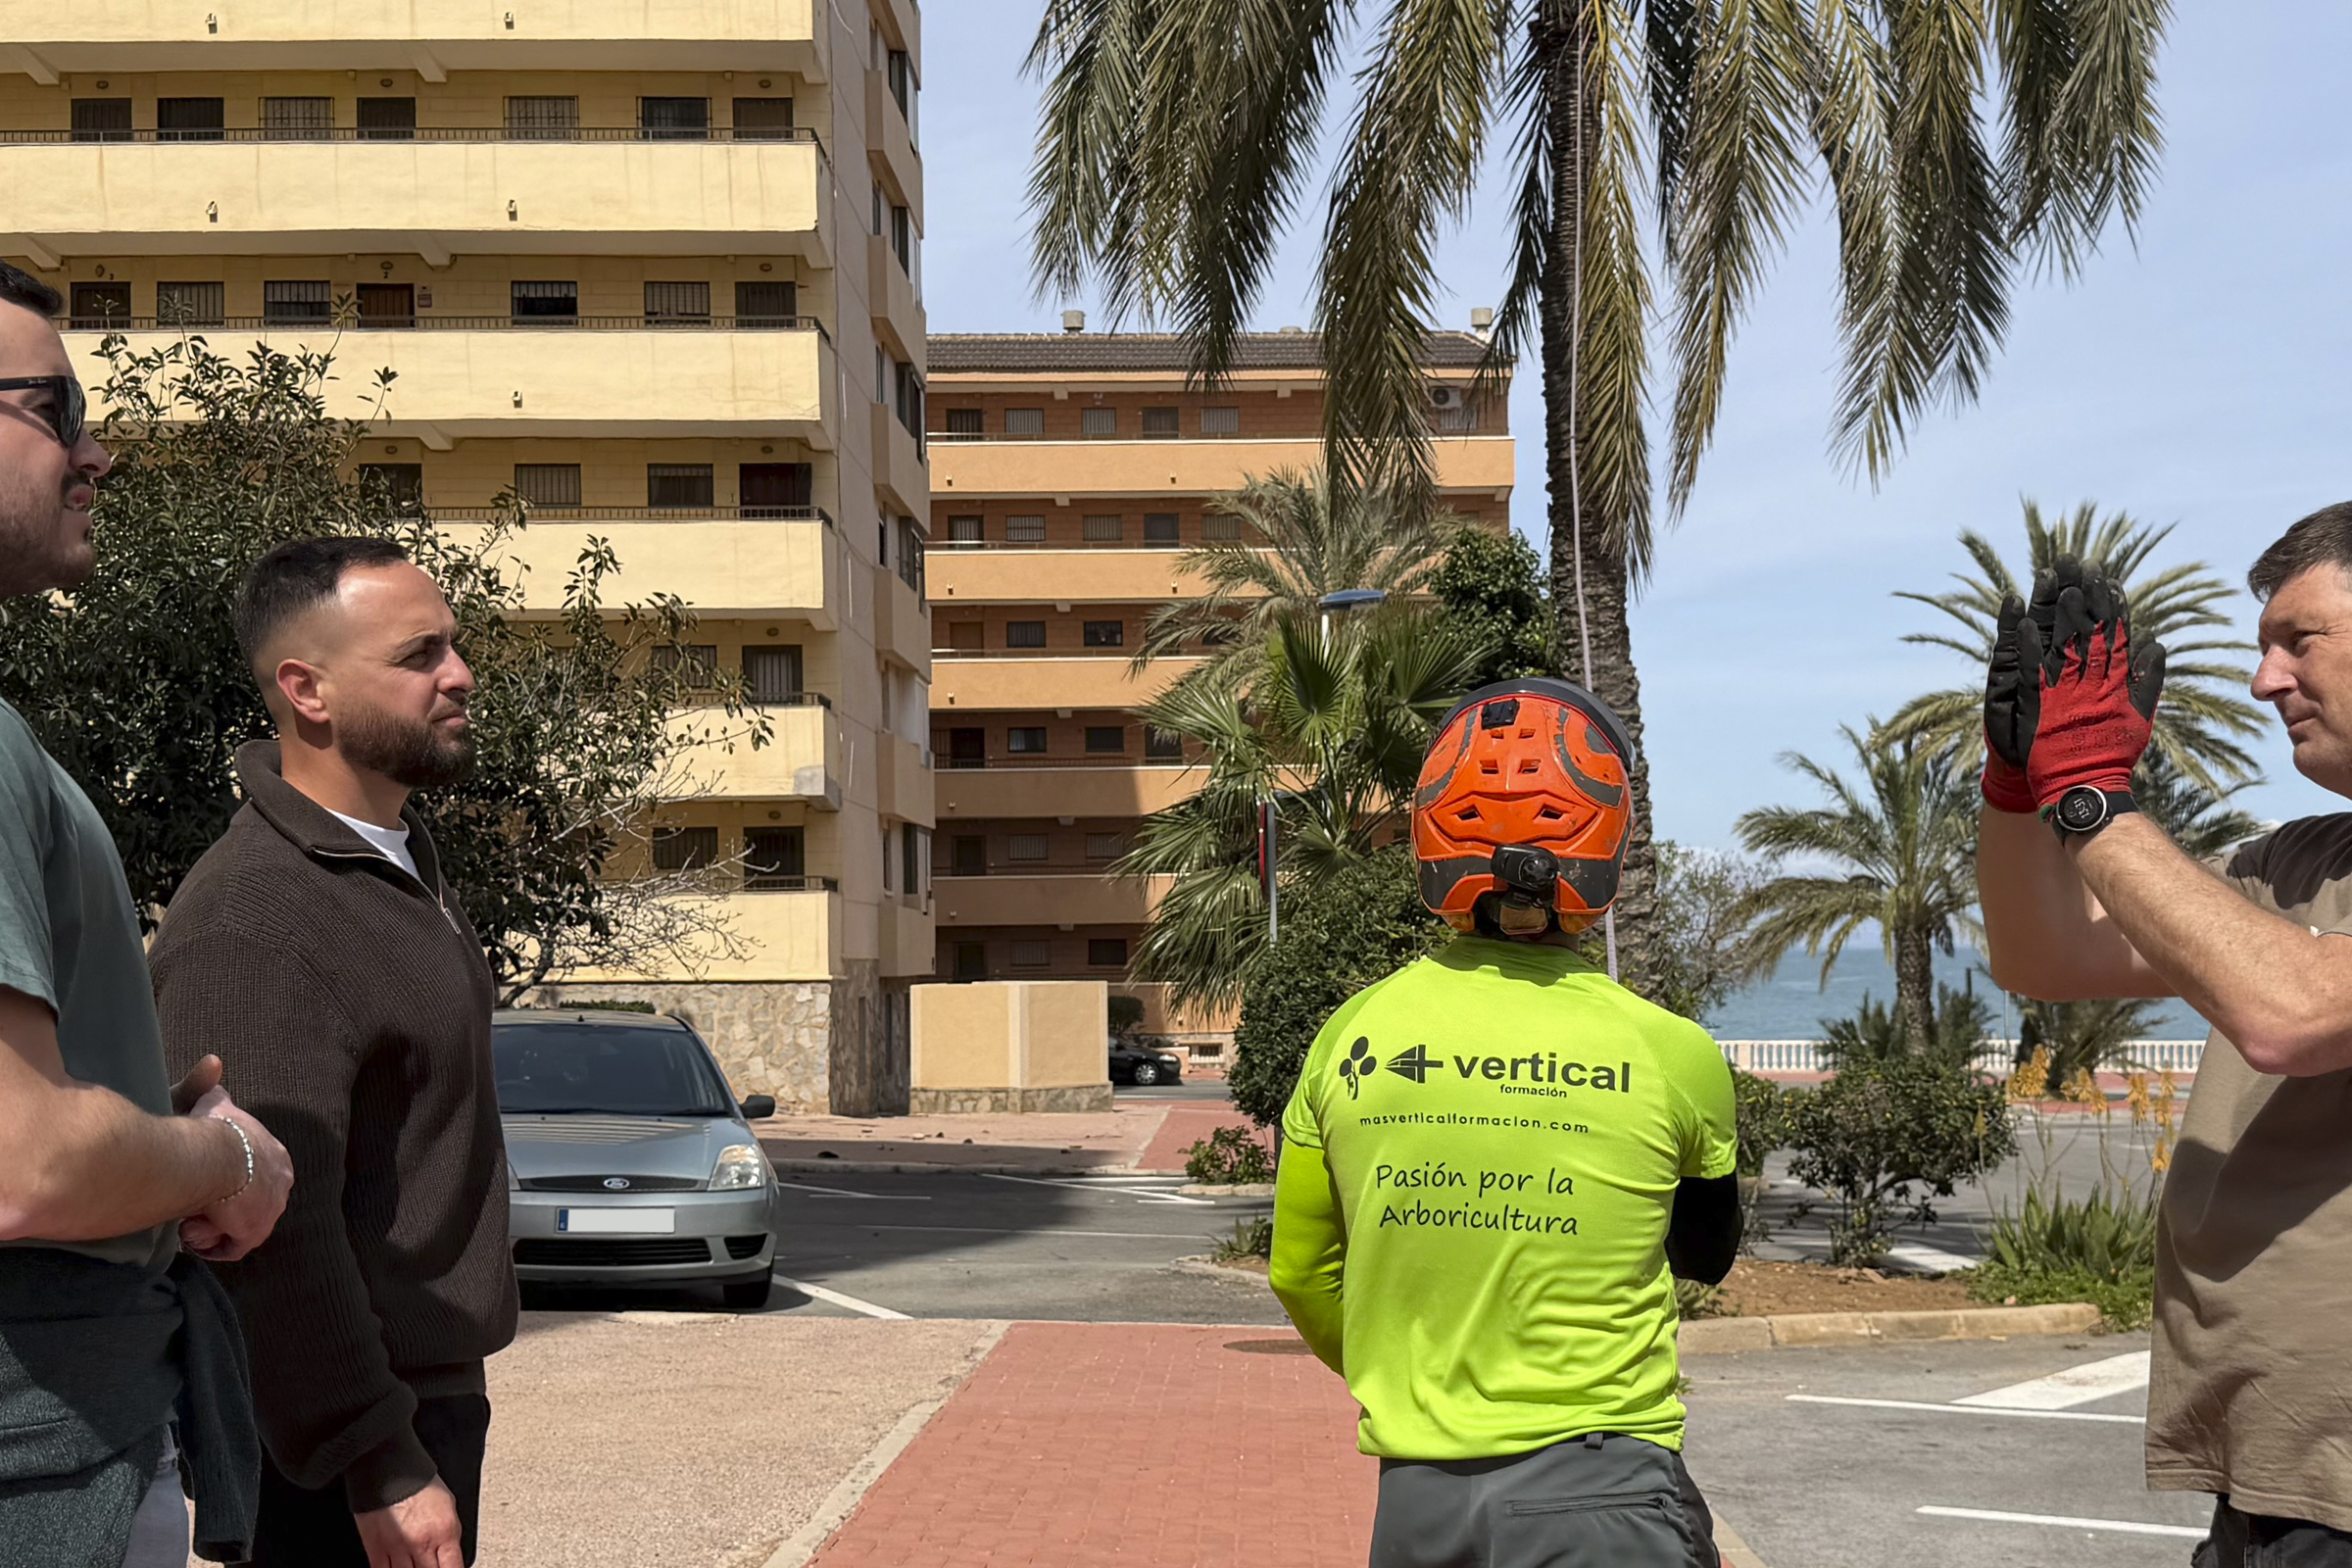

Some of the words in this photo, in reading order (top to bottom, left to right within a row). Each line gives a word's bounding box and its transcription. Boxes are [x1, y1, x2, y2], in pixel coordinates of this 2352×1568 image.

[1452, 1052, 1631, 1094] vertical
[1499, 1083, 1568, 1099] formación
[1359, 1111, 1590, 1134] masverticalformacion.com
[1376, 1161, 1467, 1190] Pasión
[1479, 1170, 1534, 1199] por
[1547, 1167, 1574, 1196] la
[1379, 1199, 1578, 1236] Arboricultura
